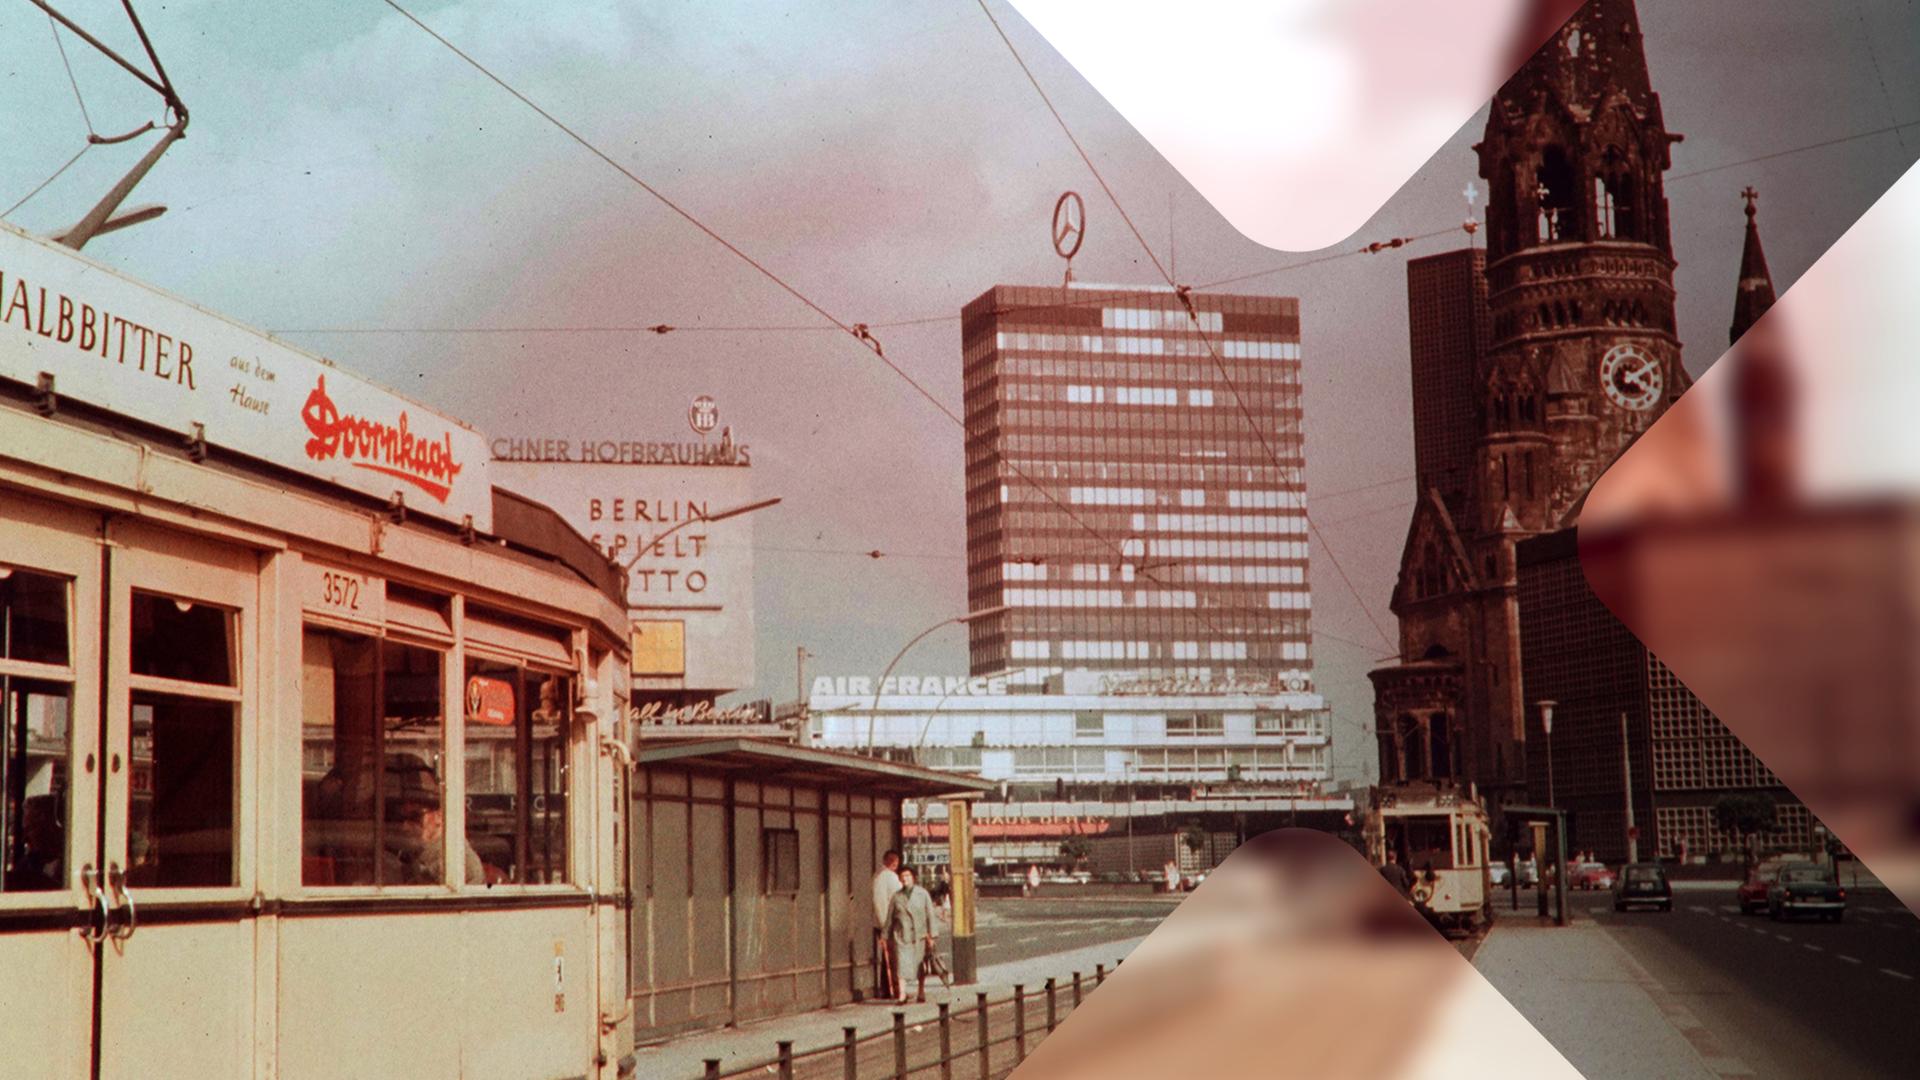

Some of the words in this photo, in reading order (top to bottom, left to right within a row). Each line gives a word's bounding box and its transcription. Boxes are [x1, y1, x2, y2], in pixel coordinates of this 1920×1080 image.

[0, 271, 196, 391] ALBBITTER
[230, 356, 250, 374] aus
[229, 383, 270, 416] Hause
[301, 373, 463, 486] Doornkaat
[491, 438, 571, 460] CHNER
[590, 498, 708, 522] BERLIN
[591, 534, 707, 558] SPIELT
[323, 571, 359, 610] 3572
[637, 569, 708, 593] TTO
[811, 675, 872, 696] AIR
[879, 675, 1008, 696] FRANCE
